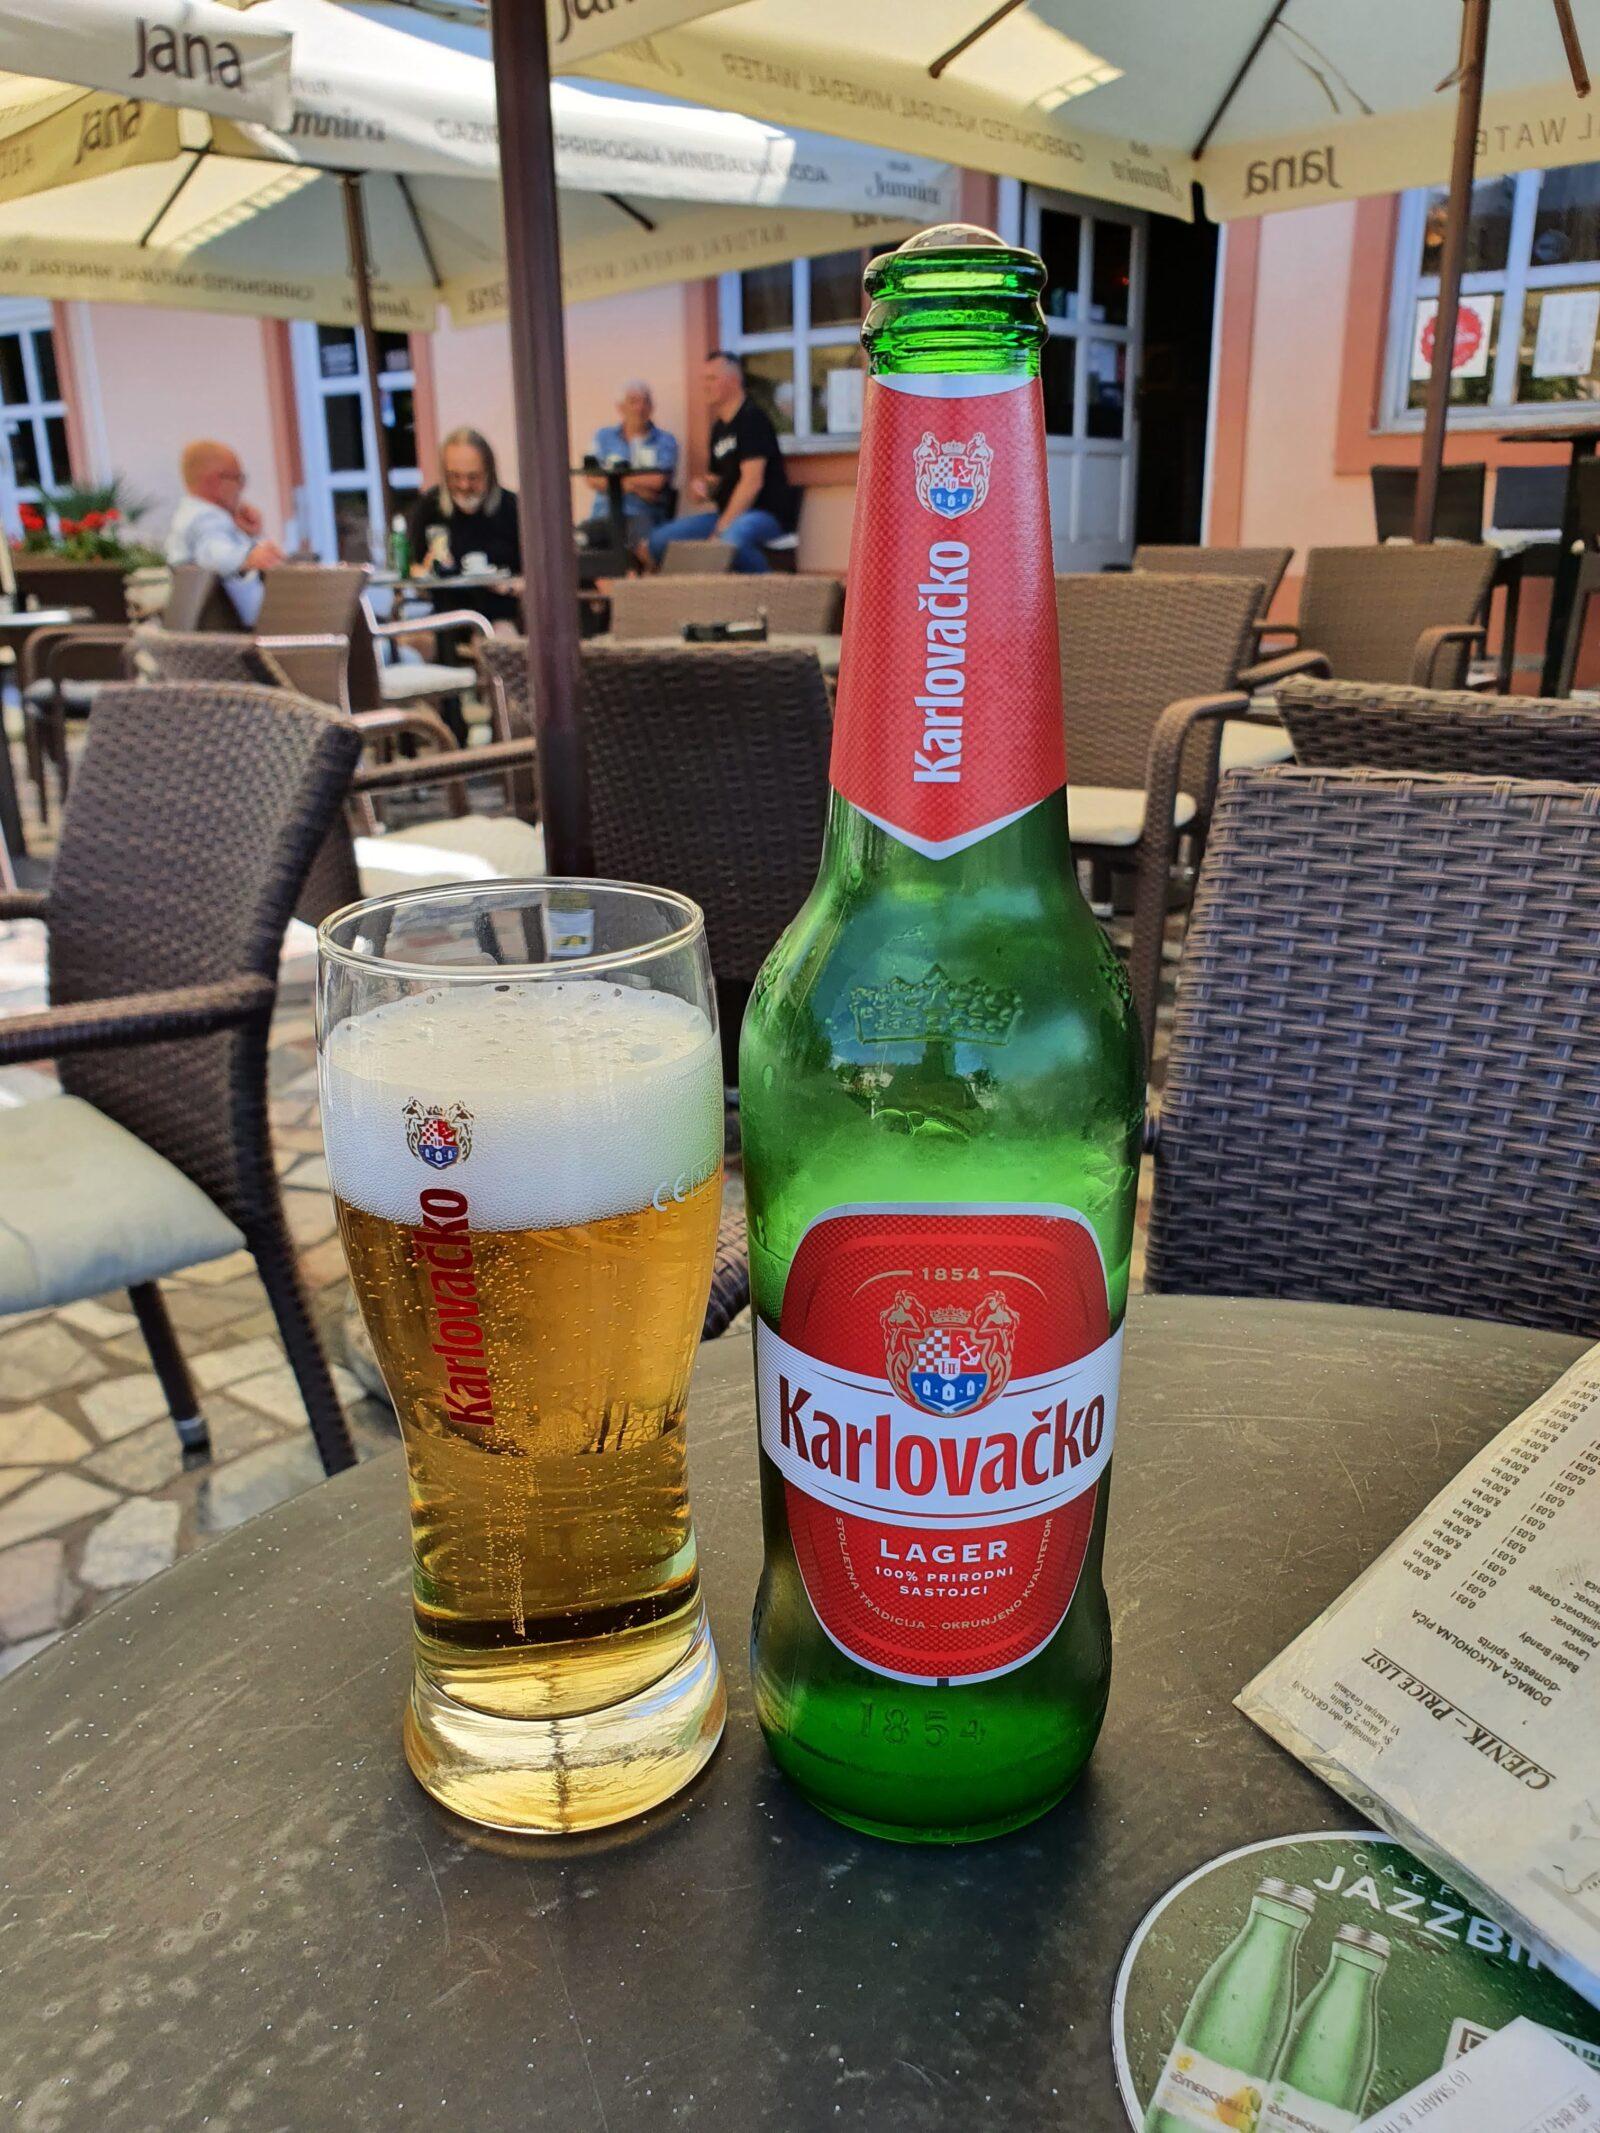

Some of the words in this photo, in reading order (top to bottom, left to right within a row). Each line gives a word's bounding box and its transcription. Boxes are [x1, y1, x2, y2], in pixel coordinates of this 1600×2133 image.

[131, 17, 242, 89] Jana
[913, 540, 970, 783] Karlovačko
[922, 1267, 981, 1282] 1854
[412, 1187, 495, 1427] Karlovačko
[779, 1374, 1105, 1497] Karlovačko
[1491, 1467, 1502, 1477] kn
[1510, 1462, 1529, 1474] 8,00
[1576, 1463, 1596, 1475] 0,03
[1482, 1478, 1492, 1487] kn
[1501, 1473, 1520, 1485] 8,00
[1565, 1472, 1585, 1485] 0,03
[1472, 1488, 1483, 1498] kn
[1491, 1483, 1511, 1496] 8,00
[1555, 1483, 1575, 1496] 0,03
[1462, 1498, 1473, 1508] kn
[1482, 1494, 1501, 1507] 8,00
[1545, 1494, 1565, 1507] 0,03
[1452, 1508, 1463, 1518] kn
[1472, 1505, 1491, 1518] 8,00
[1536, 1505, 1555, 1518] 0,03
[1443, 1519, 1453, 1529] kn
[1462, 1515, 1481, 1528] 8,00
[1526, 1517, 1545, 1530] 0,03
[1433, 1529, 1444, 1539] kn
[1452, 1525, 1471, 1539] 8,00
[1516, 1528, 1536, 1542] 0,03
[1423, 1540, 1434, 1549] kn
[1442, 1535, 1462, 1549] 8,00
[1507, 1540, 1526, 1553] 0,03
[880, 1538, 1008, 1564] LAGER
[1413, 1549, 1424, 1560] kn
[1432, 1546, 1451, 1560] 8,00
[1497, 1551, 1517, 1565] 0,03
[1403, 1560, 1414, 1570] kn
[1422, 1556, 1441, 1570] 8,00
[1487, 1562, 1507, 1576] 0,03
[836, 1517, 859, 1590] STOLJETNA
[859, 1591, 926, 1629] TRADICIJA
[941, 1598, 1022, 1630] OKRUNJENO
[1022, 1518, 1053, 1598] KVALITETOM
[875, 1566, 918, 1582] 100%
[927, 1566, 1014, 1582] PRIRODNI
[1412, 1566, 1431, 1580] 8,00
[1477, 1573, 1496, 1587] 0,03
[900, 1585, 988, 1597] SASTOJCI
[1467, 1583, 1486, 1598] 0,03
[1528, 1585, 1560, 1607] Orange
[1456, 1594, 1476, 1609] 0,03
[1412, 1610, 1436, 1629] PIĆA
[1551, 1616, 1600, 1648] Pelinkovac
[1436, 1626, 1502, 1672] ALKOHOLNA
[1477, 1636, 1509, 1659] spirits
[1519, 1632, 1552, 1656] Brandy
[1562, 1640, 1590, 1661] Lavov
[1362, 1653, 1401, 1680] LIST
[1550, 1653, 1579, 1673] Badel
[1510, 1657, 1561, 1691] -domestic
[1503, 1669, 1552, 1706] DOMAĆA
[1330, 1694, 1353, 1714] Ogulin
[1398, 1677, 1454, 1720] PRICE
[858, 1698, 988, 1748] 1854
[1463, 1727, 1550, 1789] CJENIK
[1352, 1853, 1455, 1896] CAFF
[1312, 1865, 1541, 1971] JAZZBI
[1411, 2084, 1456, 2118] SMART
